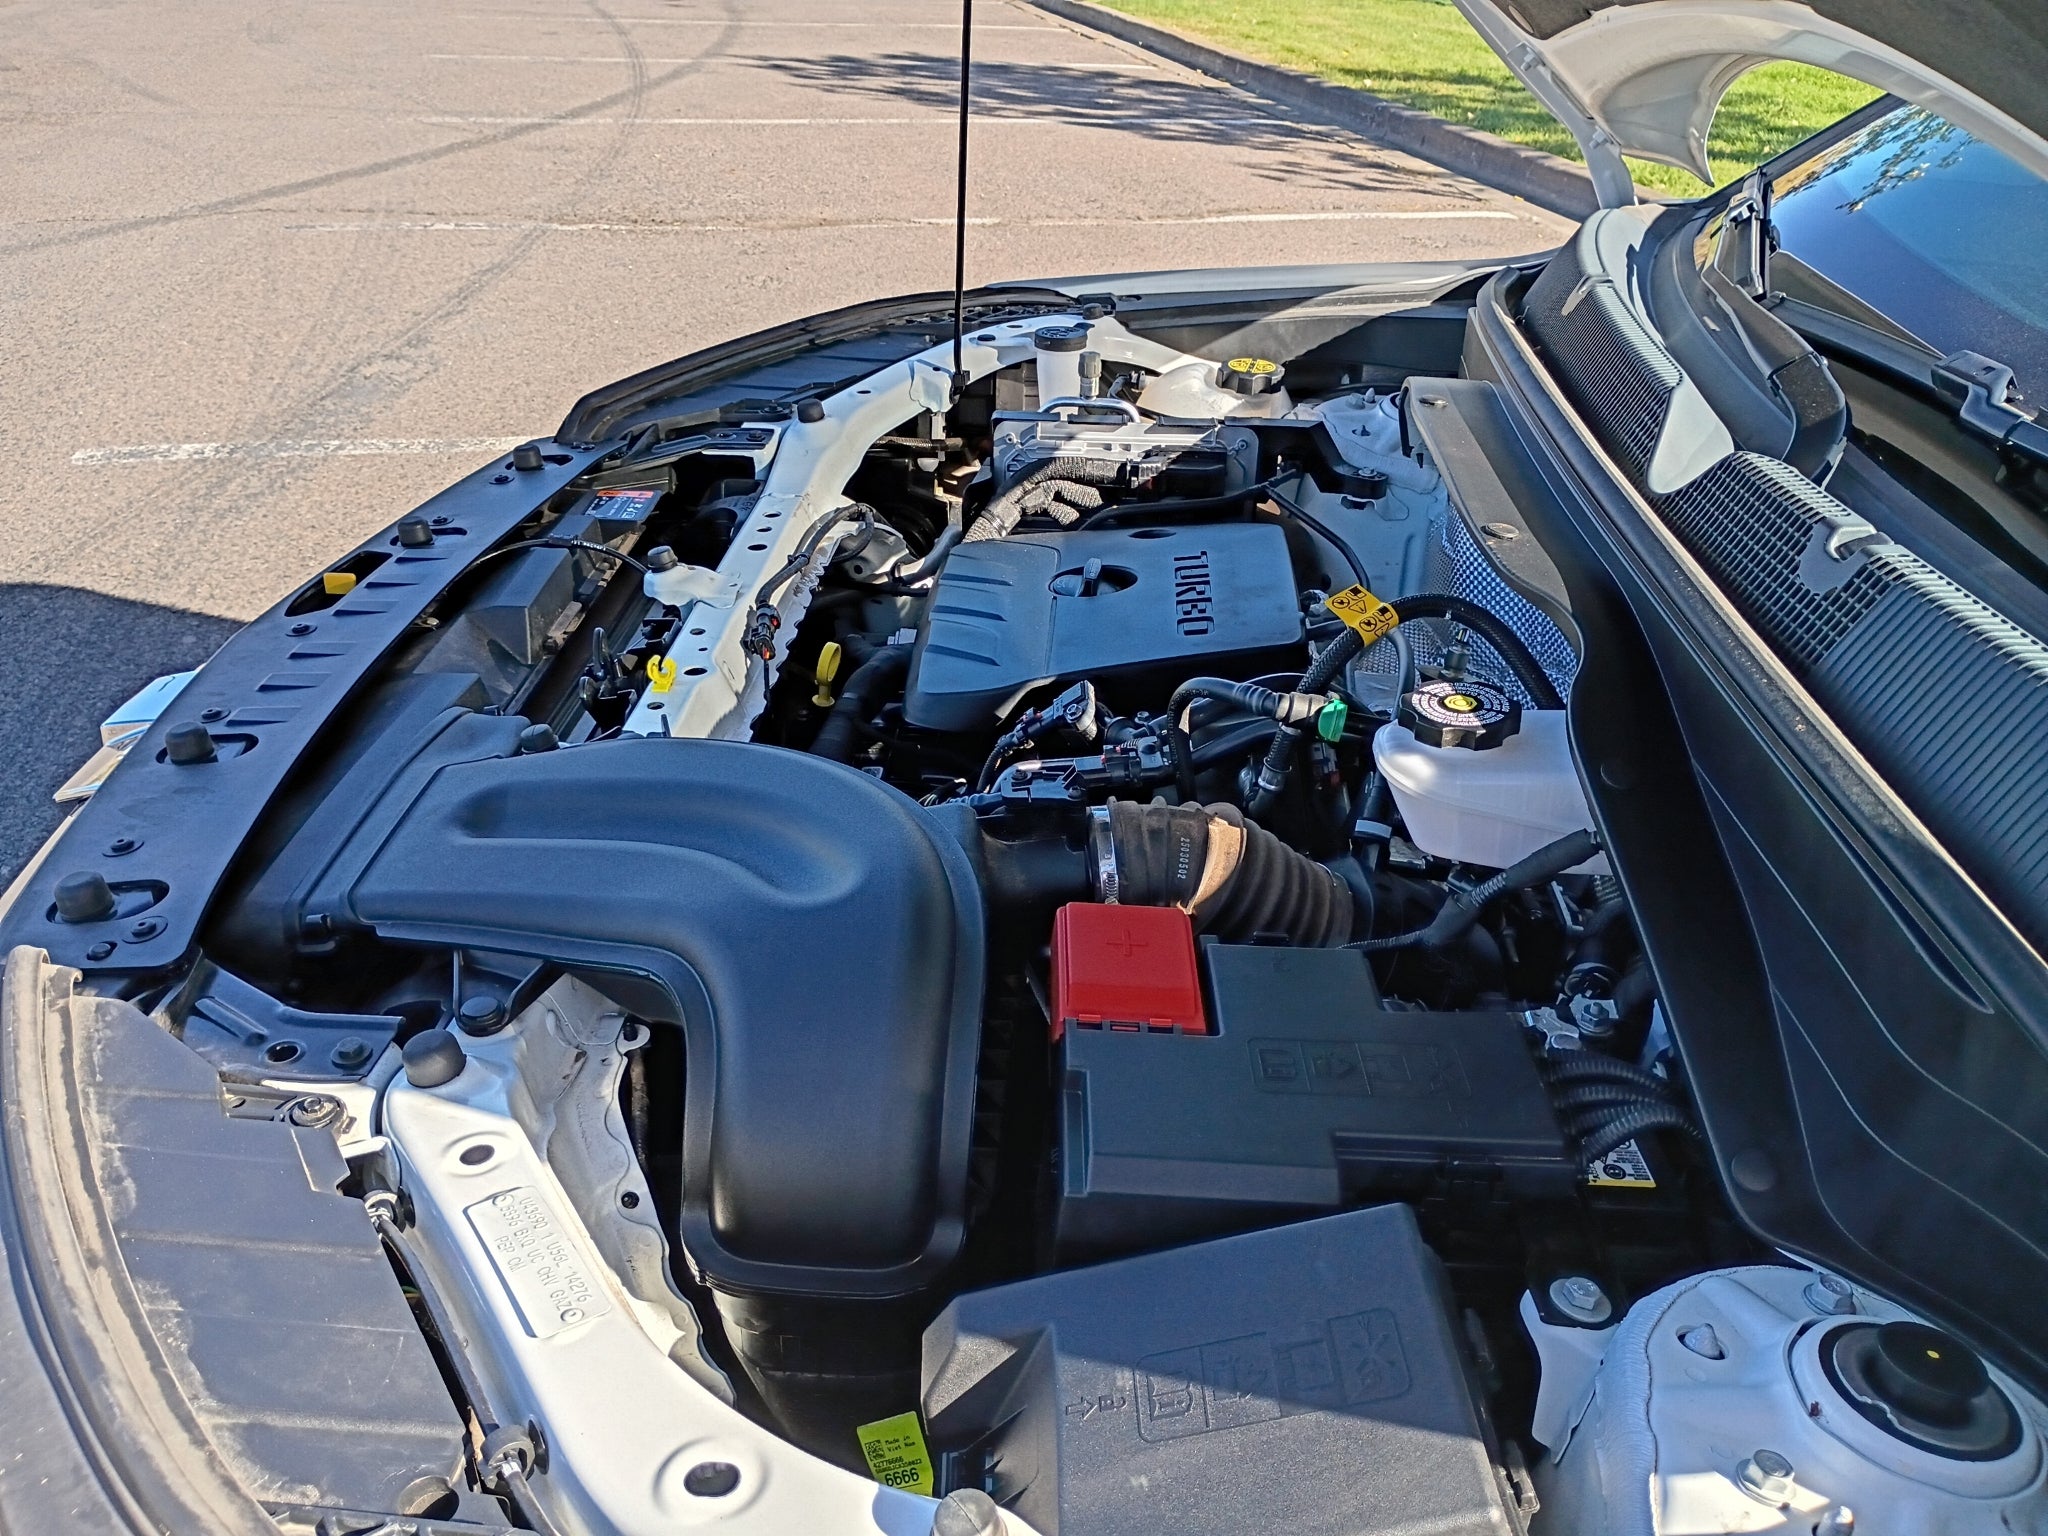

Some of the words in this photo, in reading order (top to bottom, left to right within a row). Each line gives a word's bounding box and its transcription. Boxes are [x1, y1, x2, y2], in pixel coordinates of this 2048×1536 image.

[1174, 551, 1215, 636] TURBO
[1177, 837, 1190, 879] 25030502
[527, 1249, 545, 1264] UC
[550, 1289, 572, 1311] GAZ
[886, 1444, 901, 1452] Viet
[885, 1467, 919, 1487] 6666
